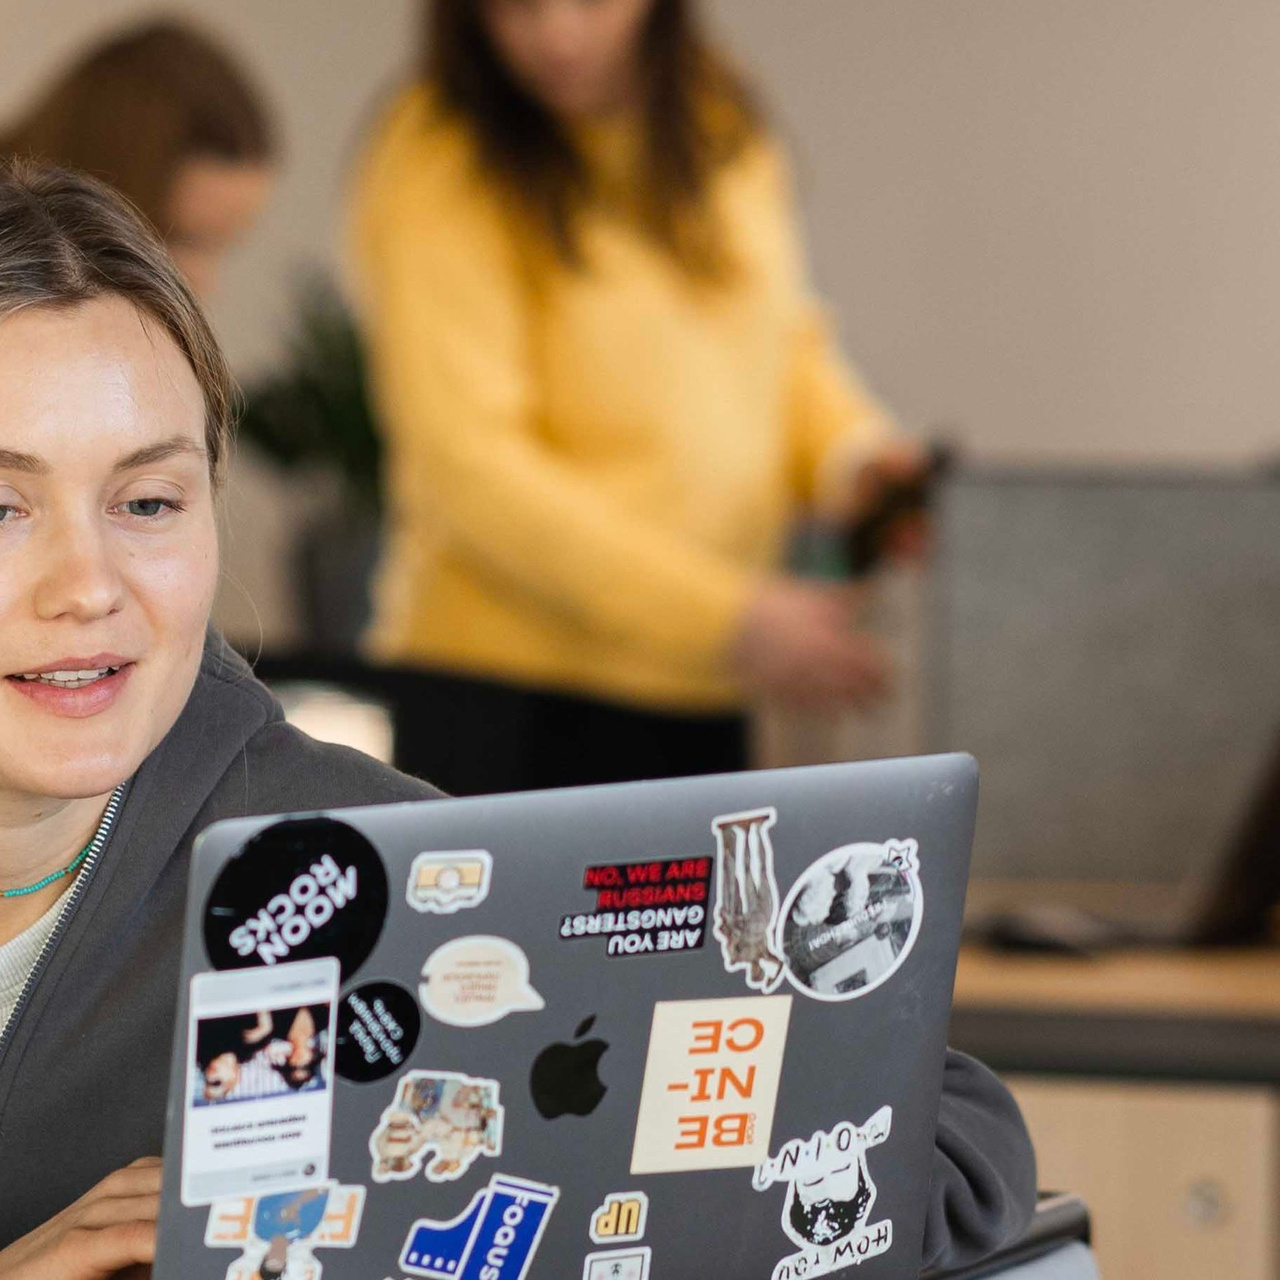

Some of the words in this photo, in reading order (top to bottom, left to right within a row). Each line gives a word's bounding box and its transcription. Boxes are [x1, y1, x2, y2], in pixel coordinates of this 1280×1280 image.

[584, 865, 623, 887] NO,
[627, 861, 661, 884] WE
[666, 857, 709, 879] ARE
[229, 853, 341, 956] ROCKS
[597, 882, 706, 909] RUSSIANS
[256, 865, 358, 965] MOON
[560, 904, 705, 938] GANGSTERS?
[607, 932, 654, 955] YOU
[656, 928, 702, 951] ARE
[688, 1017, 765, 1055] CE
[667, 1065, 756, 1102] NI-
[674, 1113, 749, 1150] BE
[595, 1199, 641, 1237] UP
[833, 1226, 888, 1263] HOW
